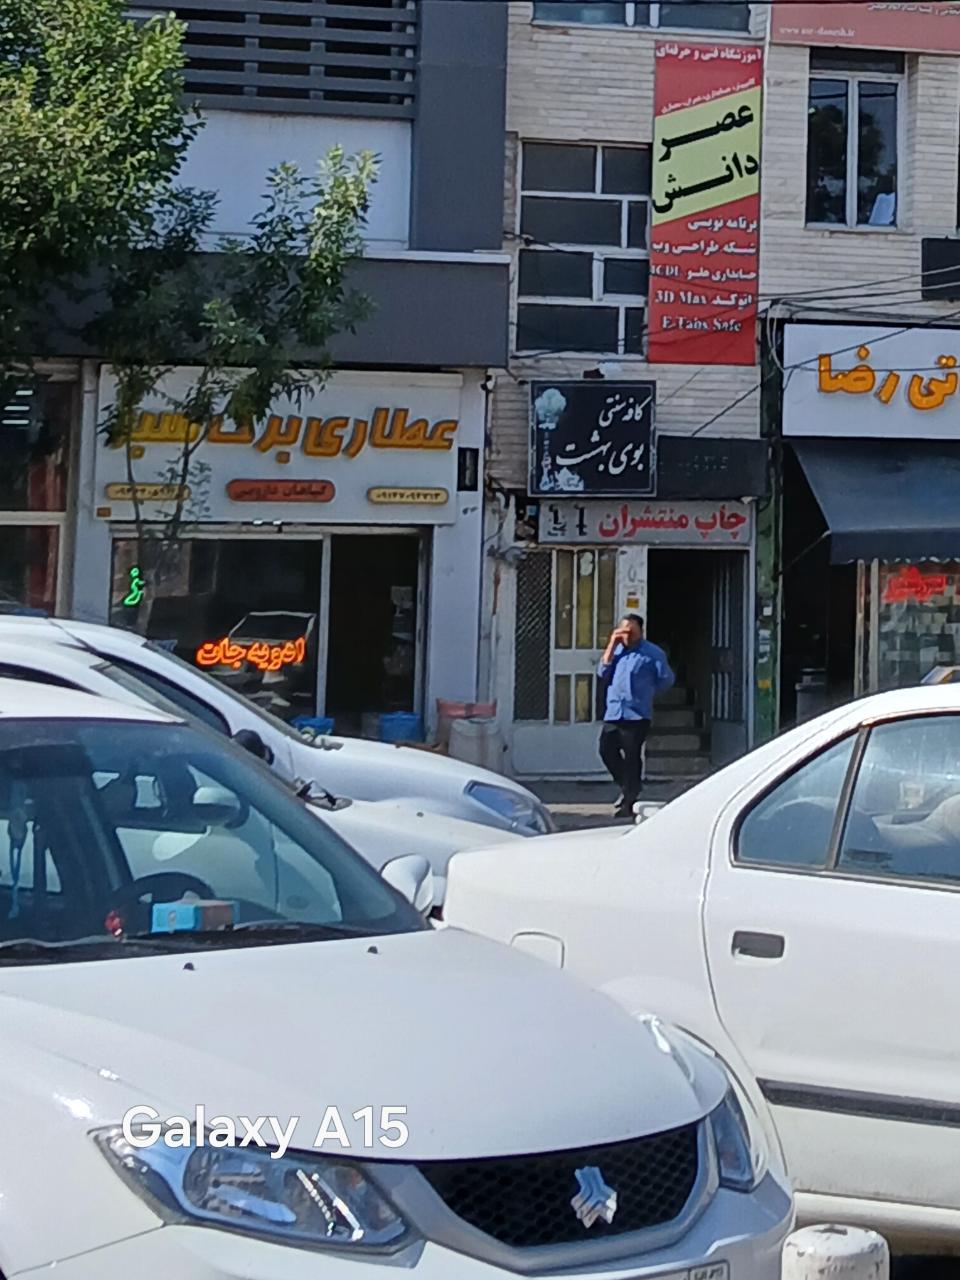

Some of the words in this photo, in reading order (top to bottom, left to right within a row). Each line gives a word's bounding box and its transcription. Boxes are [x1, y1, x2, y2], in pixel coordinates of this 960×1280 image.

[694, 50, 700, 60] و
[701, 46, 719, 60] فنی
[720, 48, 762, 63] آموزشگاه
[658, 104, 755, 162] عصر
[652, 152, 759, 214] دانش
[687, 218, 724, 232] نویسی
[726, 216, 758, 233] برنامه
[652, 241, 670, 254] وب
[672, 240, 719, 255] طراحی
[723, 241, 757, 254] شبکه
[711, 267, 757, 281] حسابداری
[655, 290, 675, 303] 3D
[680, 291, 707, 304] Max
[711, 293, 753, 310] اتوکد
[816, 345, 900, 405] رضا
[599, 394, 627, 428] سنتی
[622, 395, 652, 421] کافه
[110, 409, 199, 460] سب
[302, 407, 459, 459] عطاری
[556, 430, 612, 472] بهشت
[608, 443, 645, 475] بوی
[598, 504, 690, 538] منتشران
[694, 504, 747, 540] چاپ
[196, 636, 247, 670] جات
[248, 637, 306, 670] ادویه
